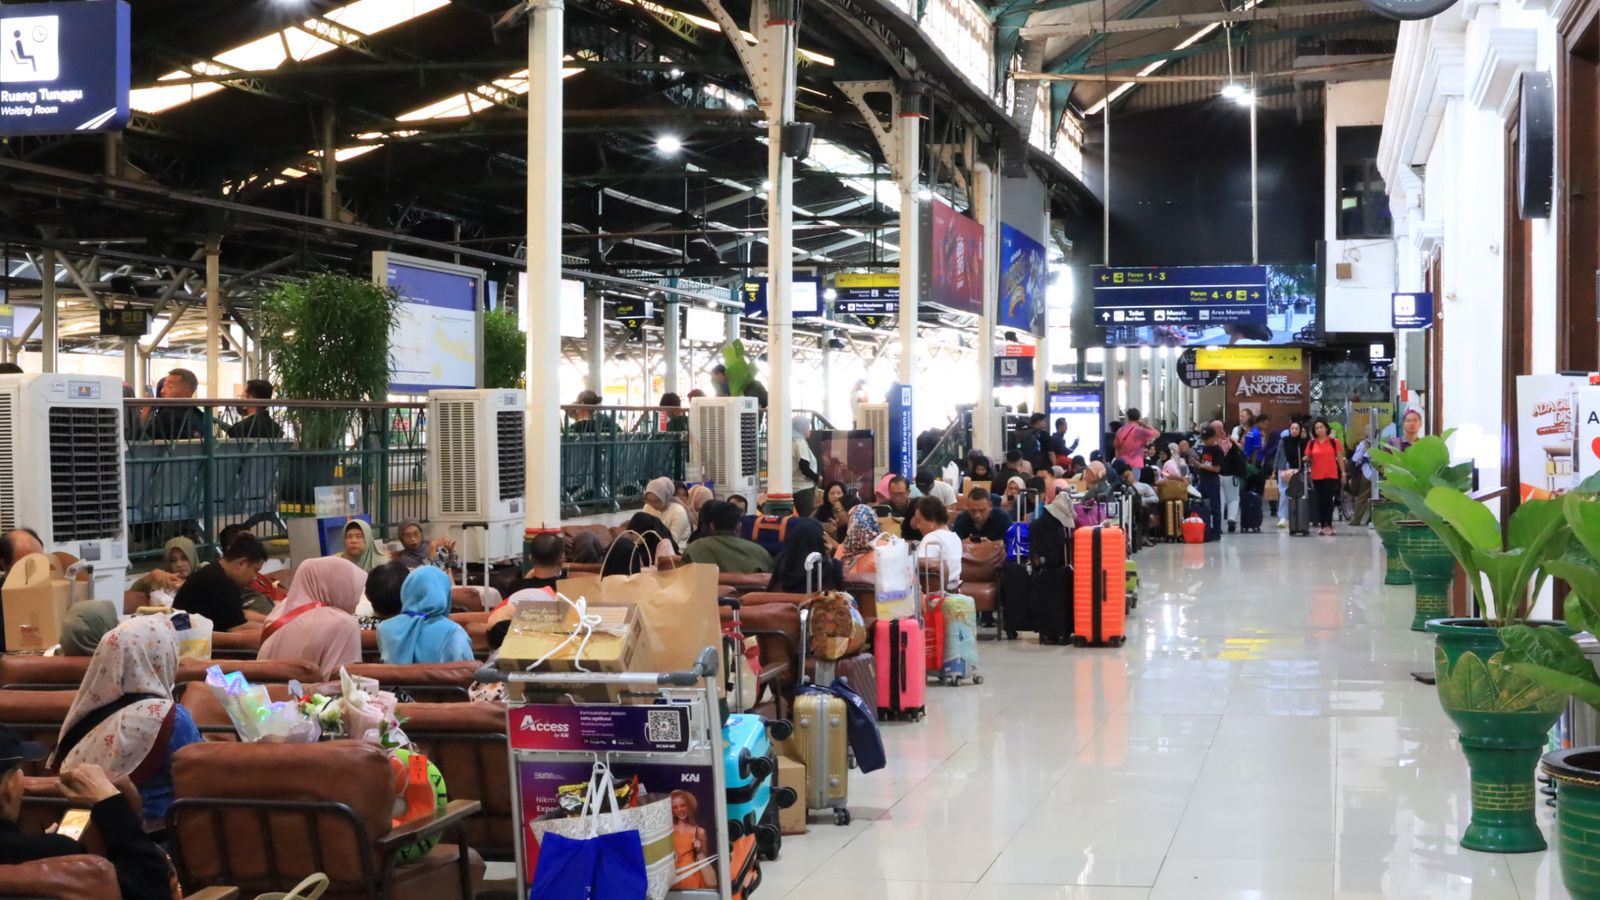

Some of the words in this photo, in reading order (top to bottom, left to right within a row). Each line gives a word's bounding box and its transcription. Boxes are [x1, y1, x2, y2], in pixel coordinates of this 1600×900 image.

[1, 90, 37, 103] Ruang
[39, 88, 83, 102] Tunggu
[1, 106, 33, 116] Waiting
[34, 105, 58, 114] Room
[749, 291, 756, 302] 3
[628, 319, 637, 328] 2
[867, 316, 875, 325] 3
[1252, 375, 1288, 384] LOUNGE
[519, 714, 569, 732] Access
[680, 773, 701, 783] KAI
